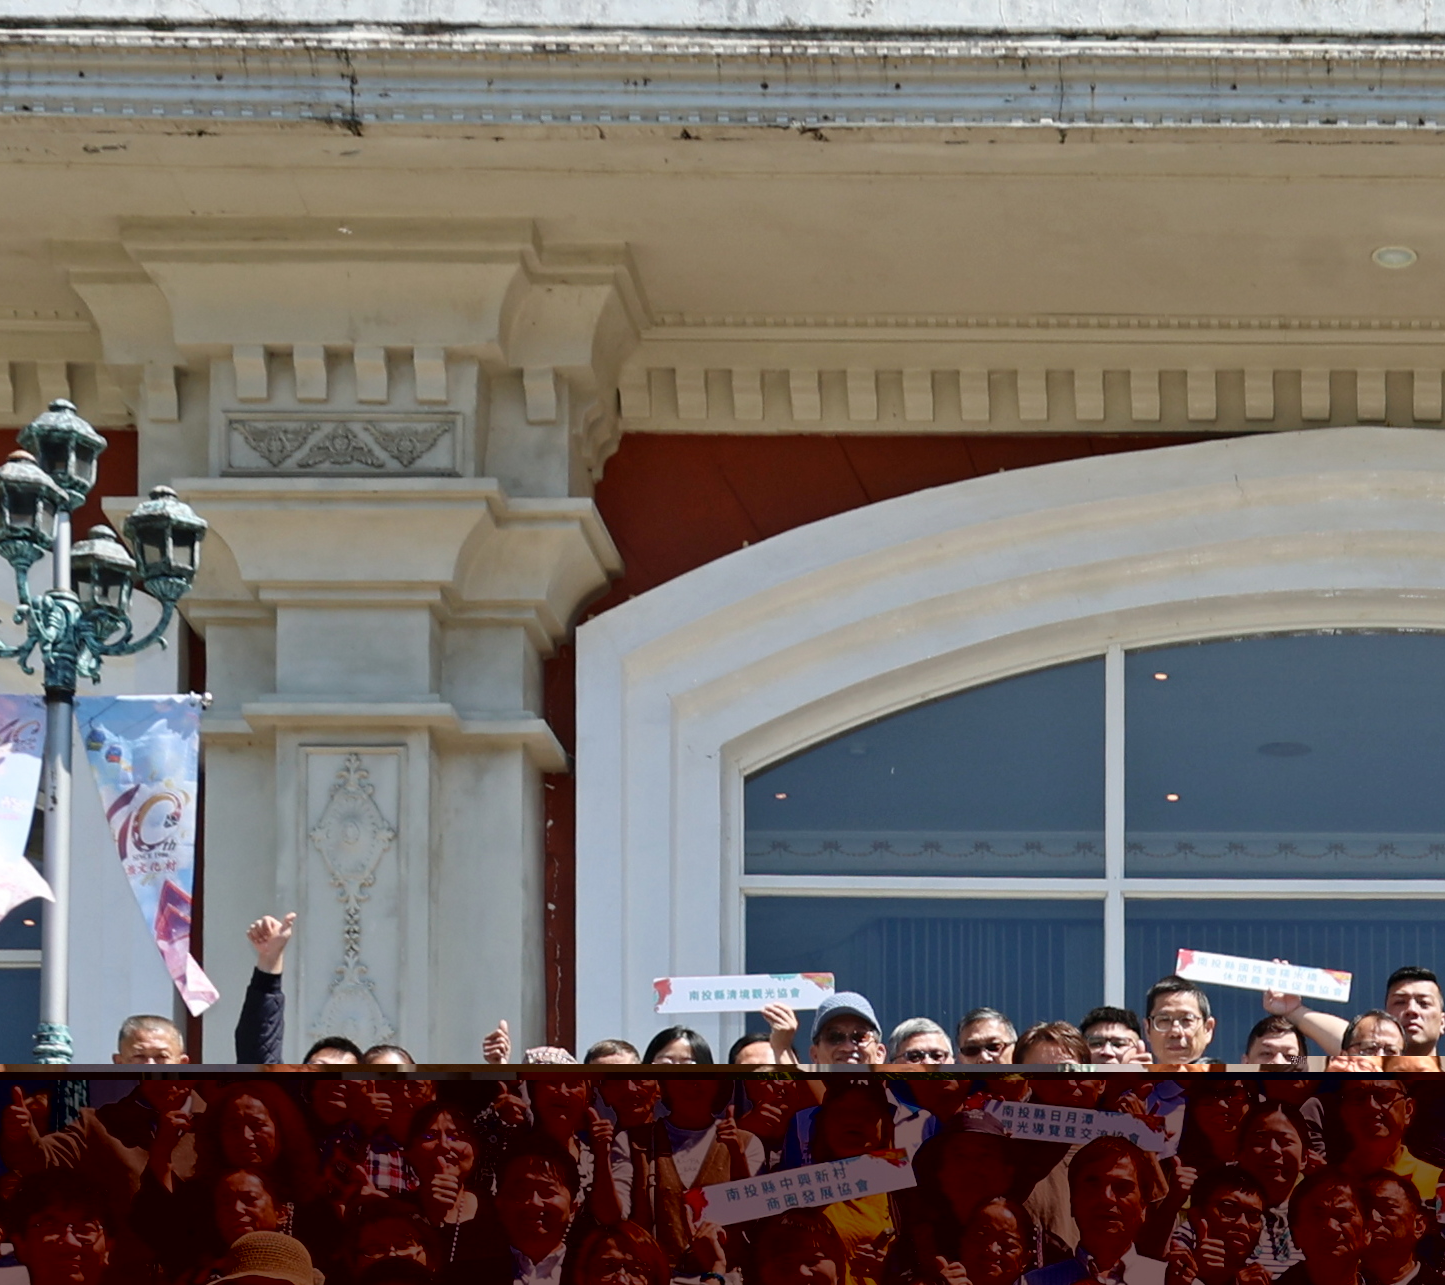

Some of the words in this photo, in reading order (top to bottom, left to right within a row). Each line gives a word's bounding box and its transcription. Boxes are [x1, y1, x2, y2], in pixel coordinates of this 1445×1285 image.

[688, 987, 801, 1002] 南投縣清境觀光協會
[1001, 1105, 1095, 1125] 南投縣日月潭
[725, 1164, 848, 1203] 南投縣中興新村
[766, 1177, 869, 1212] 商圈發展協會
